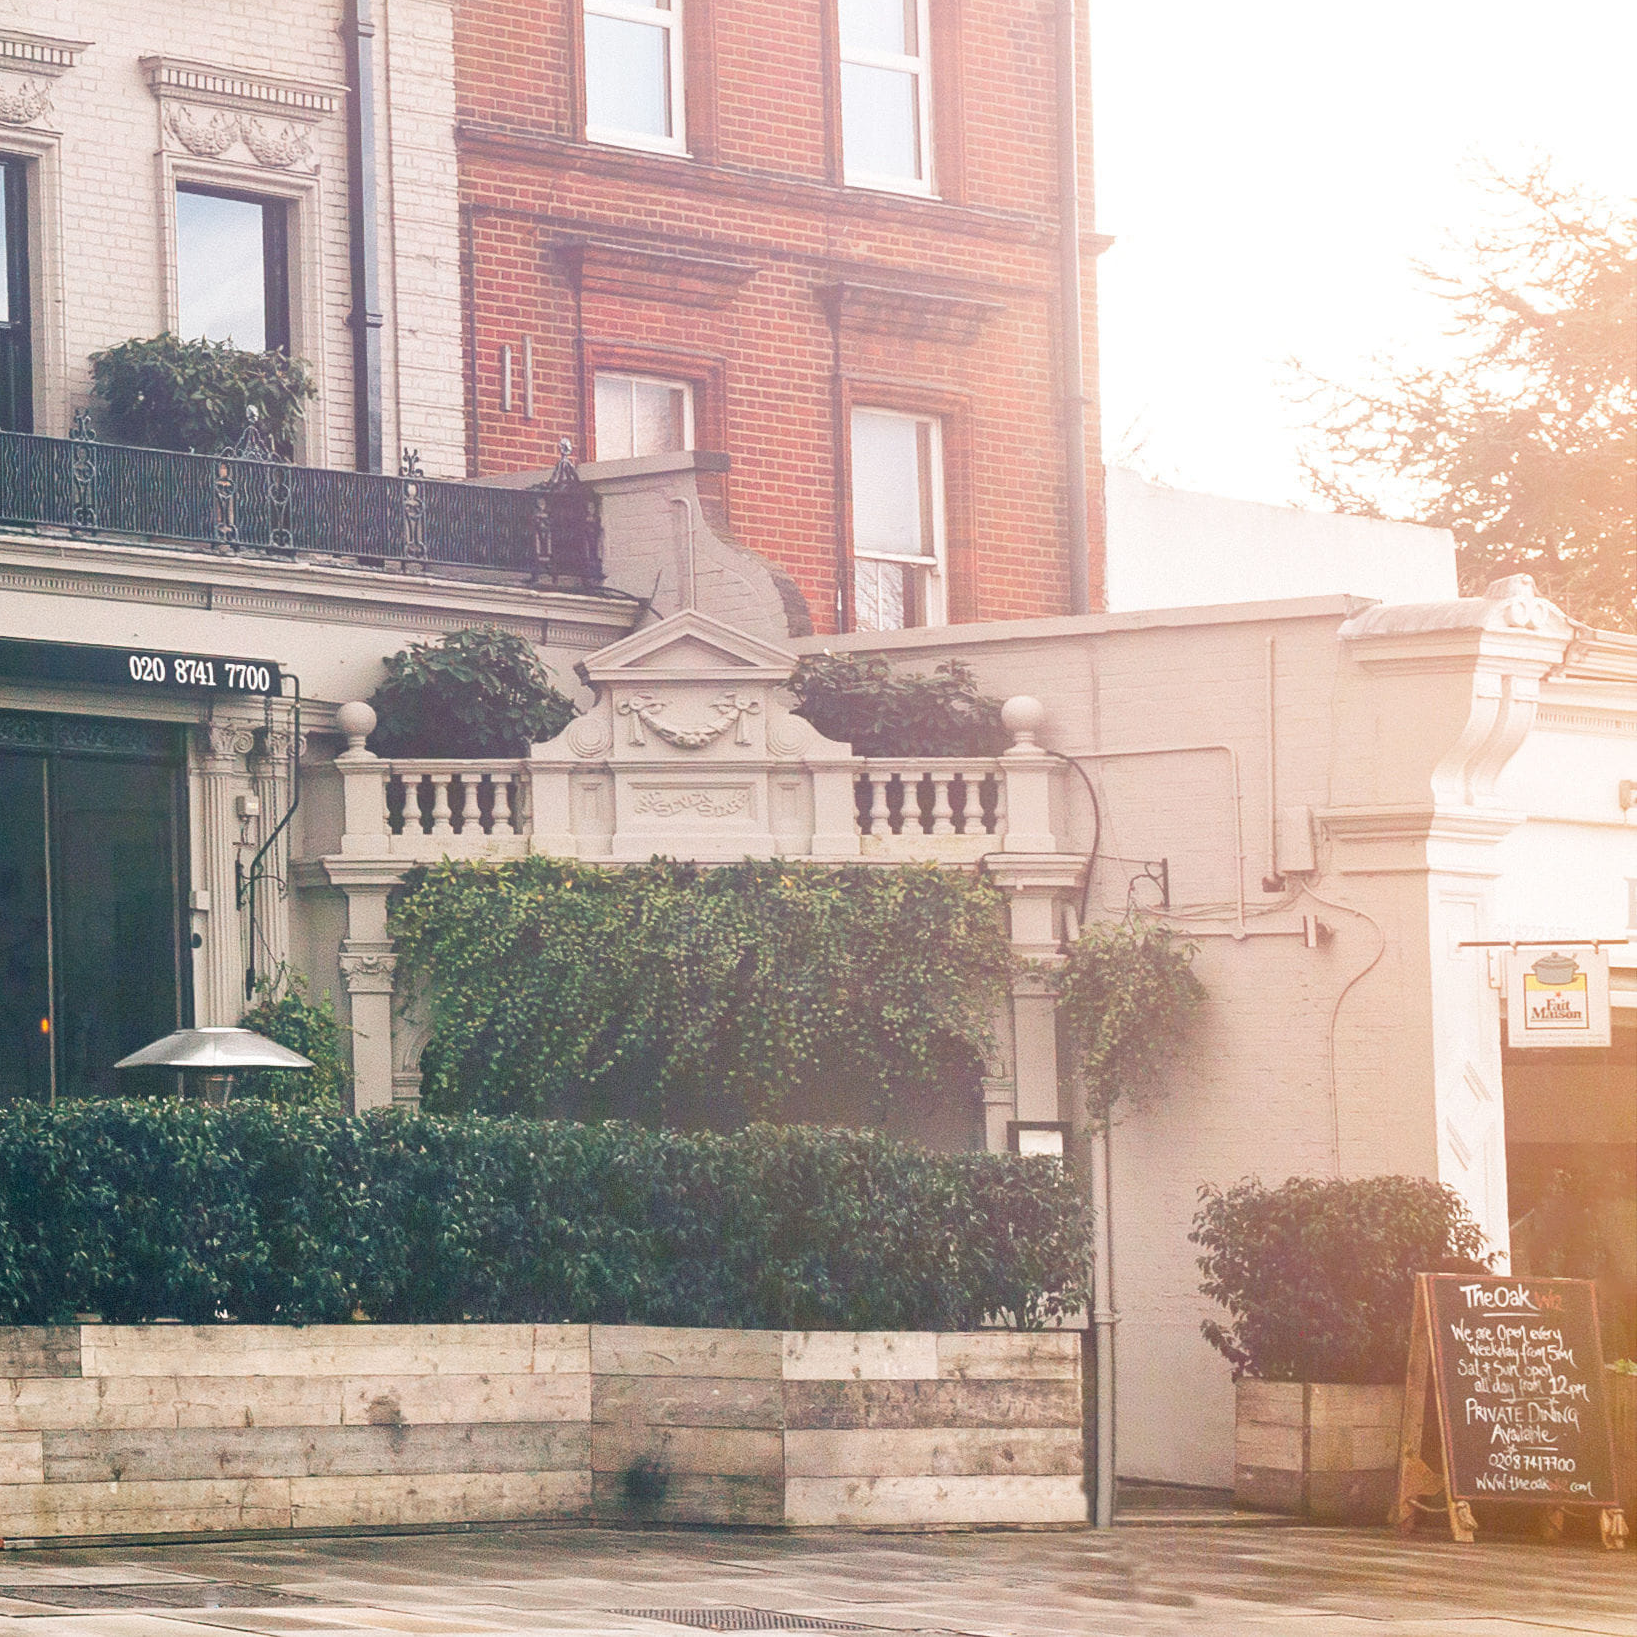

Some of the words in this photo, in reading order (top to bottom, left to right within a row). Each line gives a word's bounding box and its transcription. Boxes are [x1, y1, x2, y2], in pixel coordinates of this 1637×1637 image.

[129, 655, 166, 682] 020
[174, 659, 217, 686] 8741
[225, 663, 270, 692] 7700
[1531, 1007, 1582, 1020] Maison
[1546, 998, 1570, 1011] Fait
[1459, 1284, 1492, 1308] The
[1494, 1283, 1541, 1311] Oak
[1451, 1319, 1474, 1342] We
[1530, 1326, 1563, 1348] every
